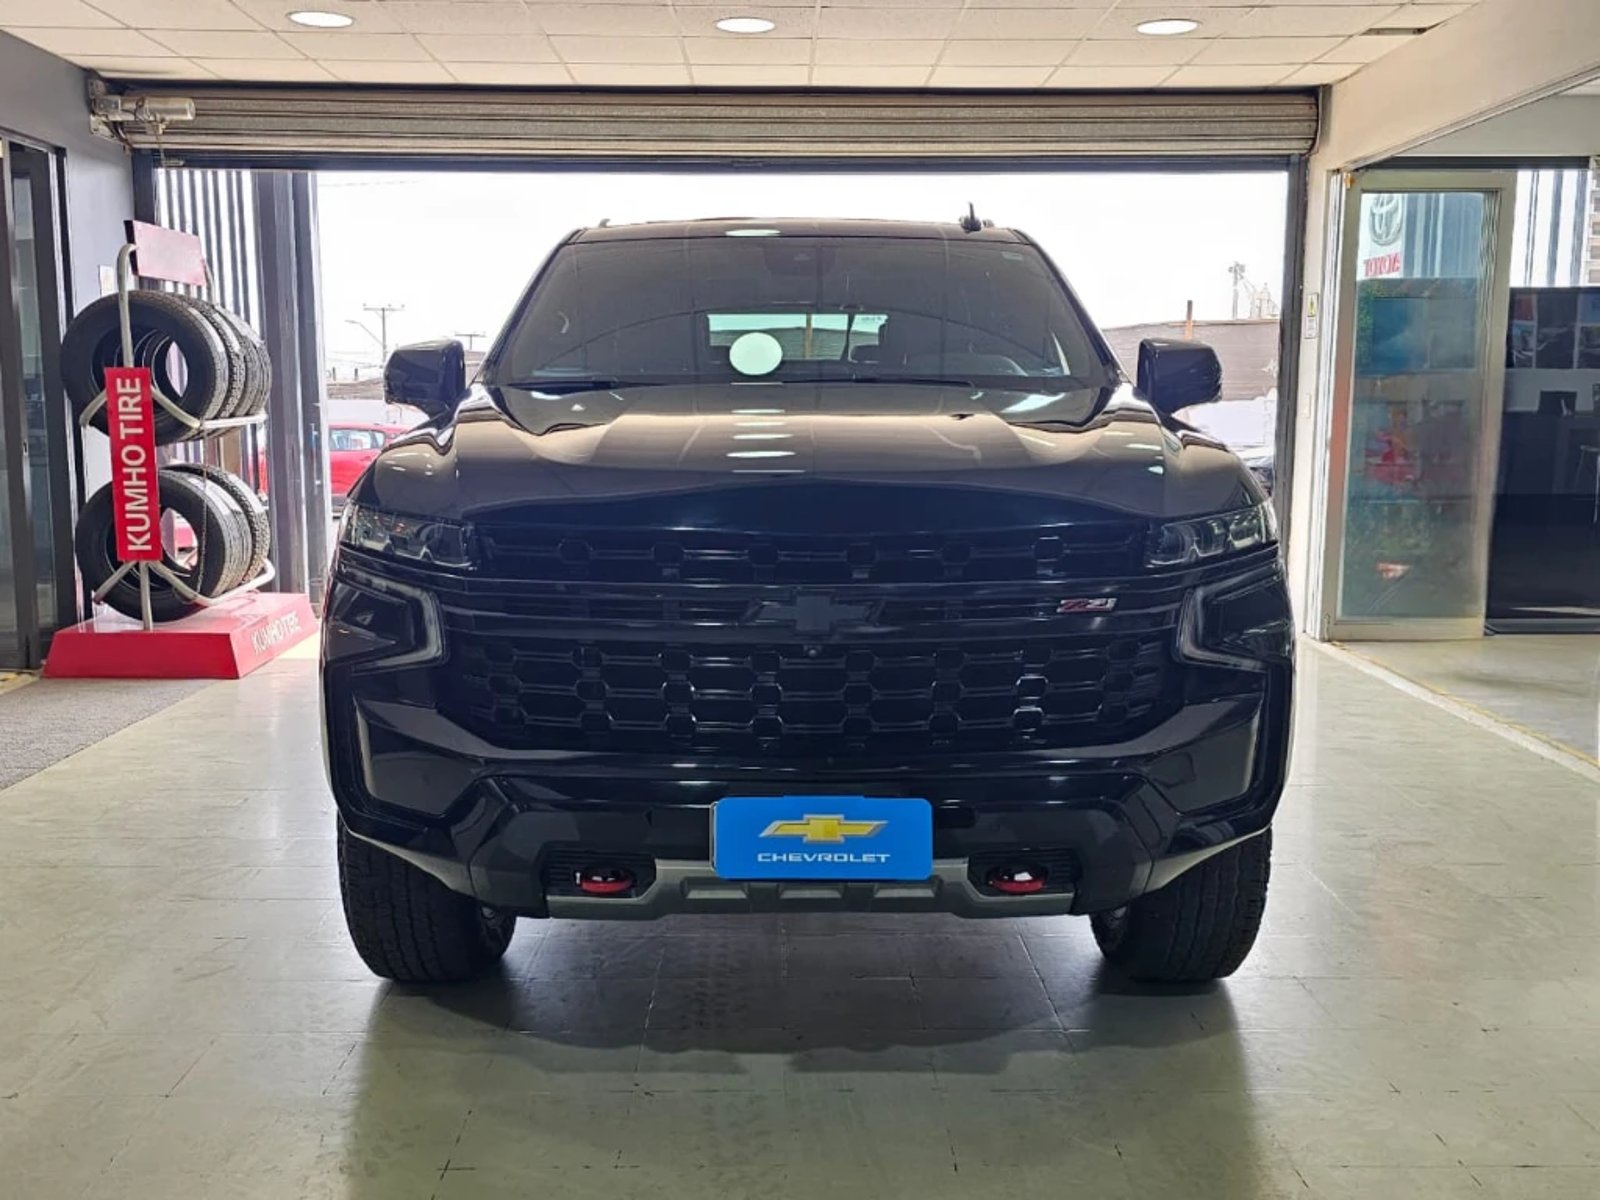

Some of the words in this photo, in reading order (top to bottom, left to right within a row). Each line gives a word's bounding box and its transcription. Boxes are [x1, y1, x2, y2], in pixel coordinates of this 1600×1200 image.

[116, 377, 144, 440] TIRE
[121, 444, 152, 551] KUMHO
[757, 852, 891, 863] CHEVROLET
